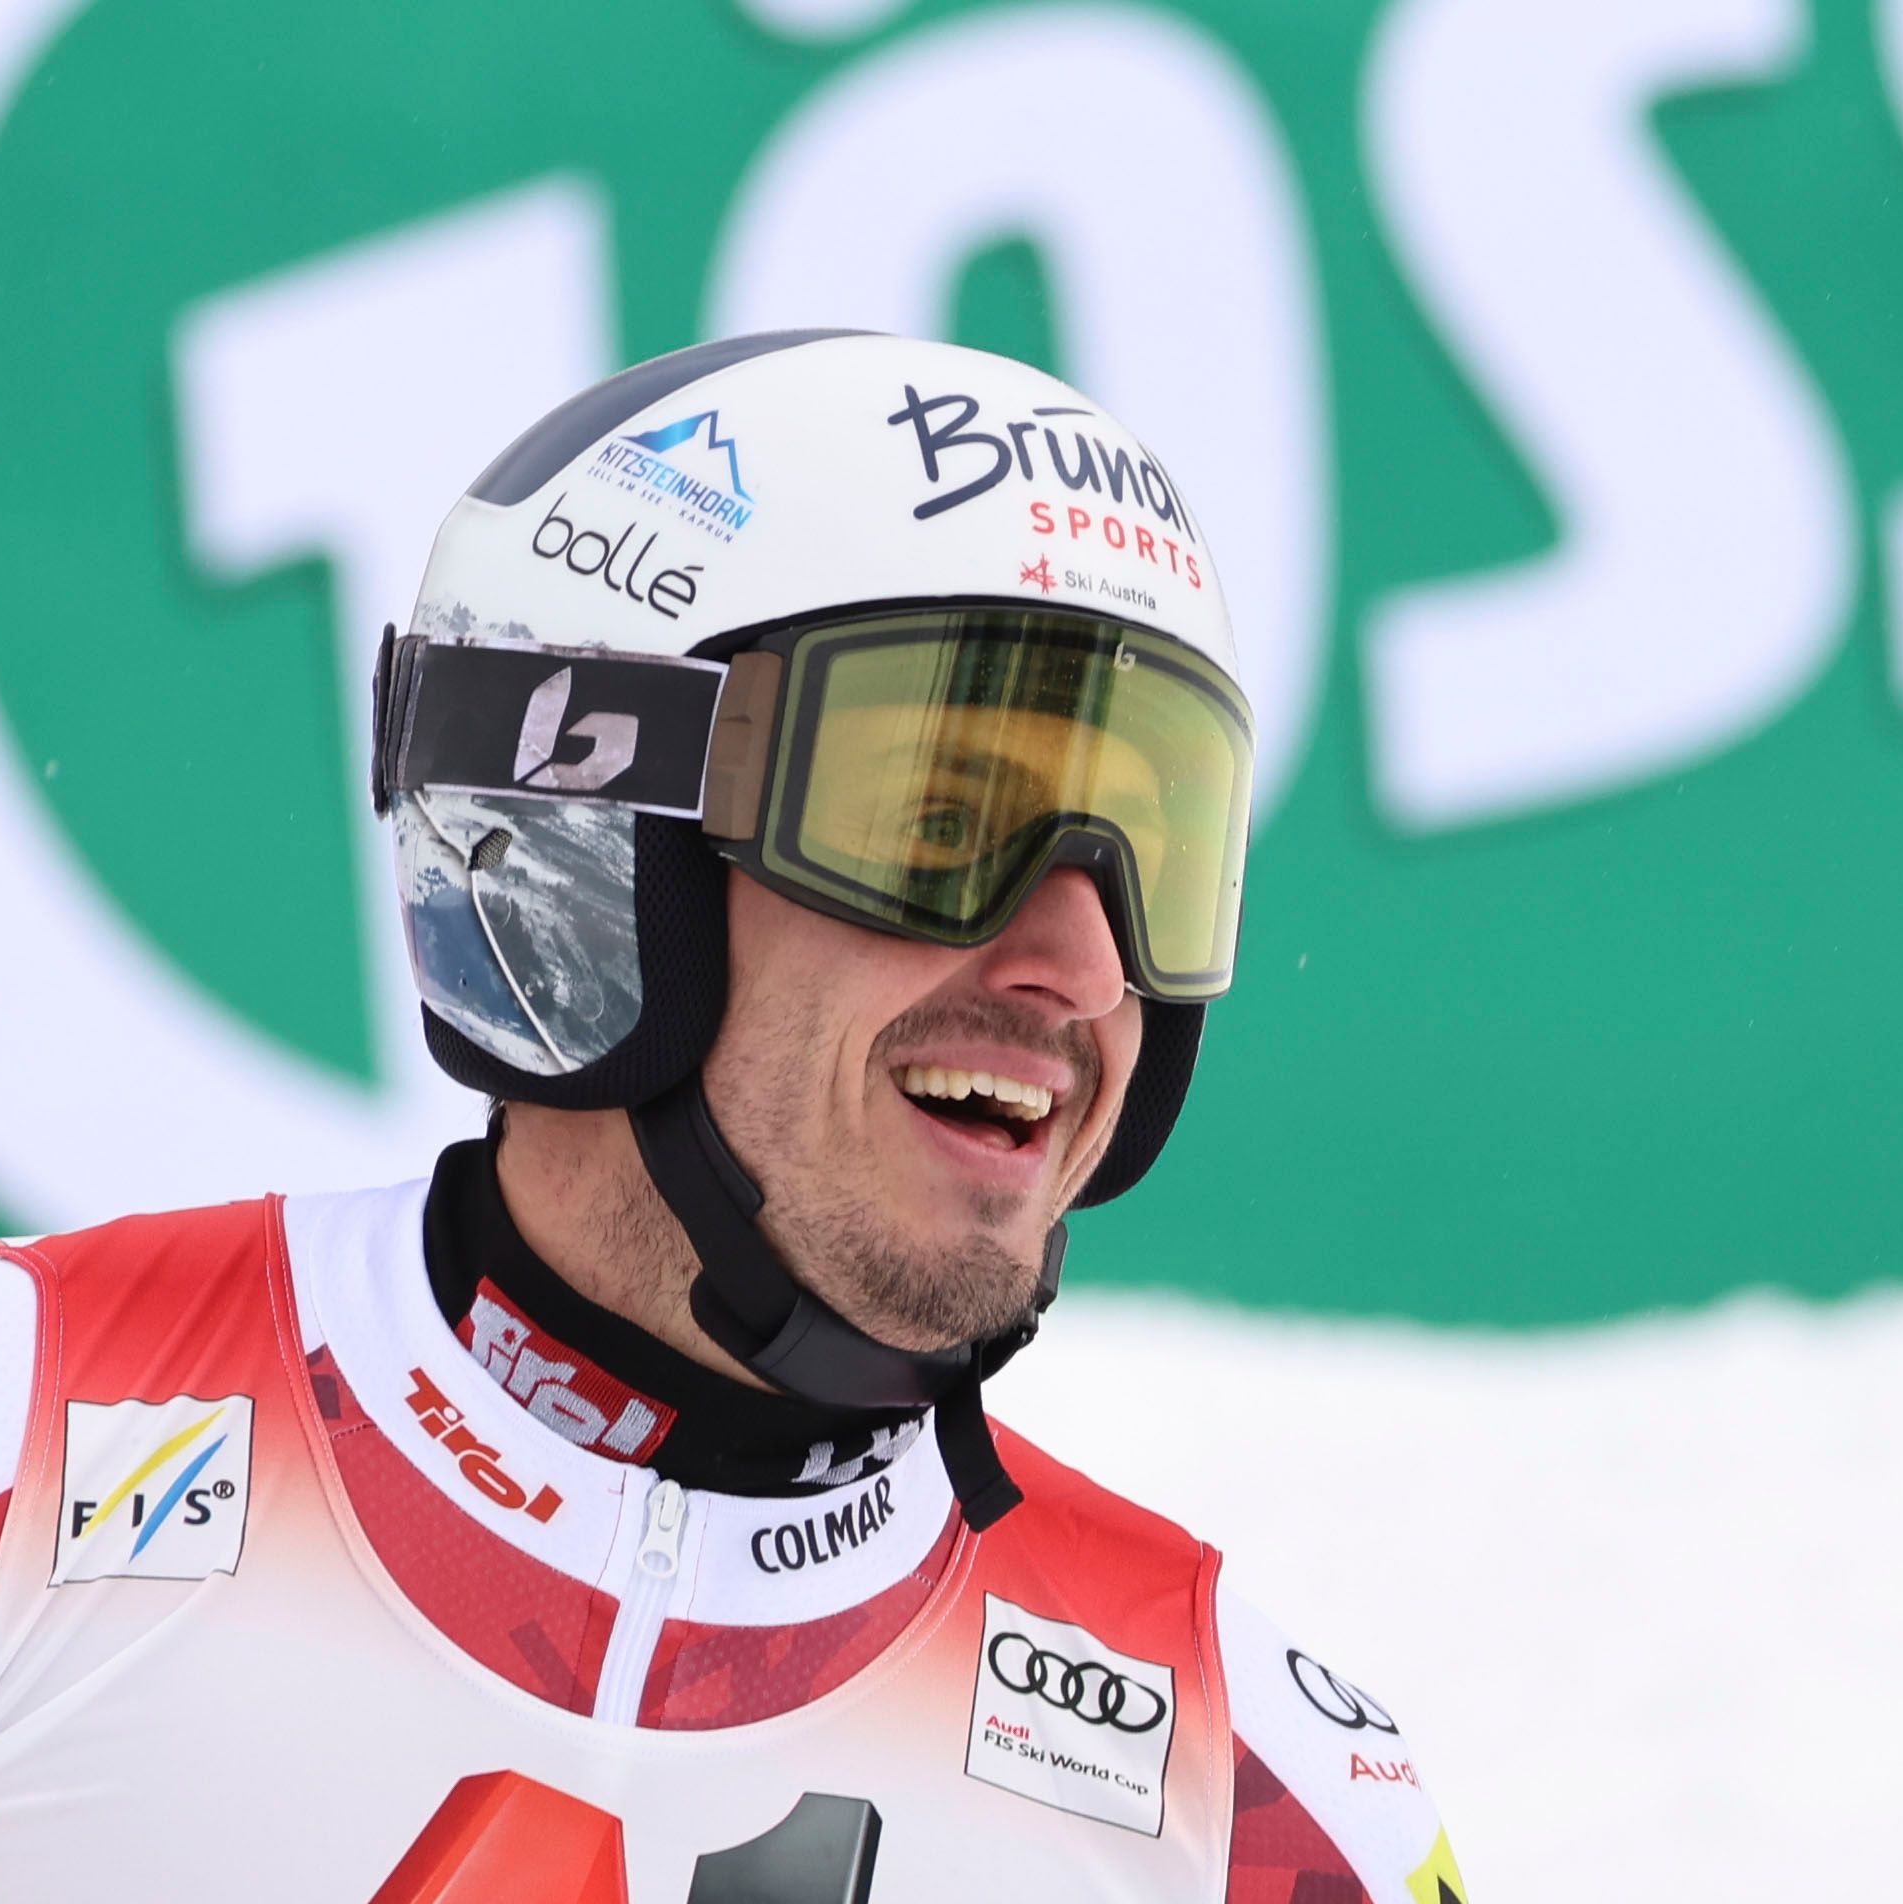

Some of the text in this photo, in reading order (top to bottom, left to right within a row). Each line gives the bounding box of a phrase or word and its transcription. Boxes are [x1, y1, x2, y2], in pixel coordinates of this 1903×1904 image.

[587, 465, 734, 545] ZELL AM SEE KAPRUN
[597, 442, 753, 530] KITZSTEINHORN
[532, 491, 704, 620] bollé
[1030, 502, 1201, 589] SPORTS
[1065, 570, 1156, 610] Ski Austria
[405, 1367, 564, 1524] Tirol
[751, 1474, 896, 1575] COLMAR
[984, 1730, 1148, 1795] FIS Ski World Cup
[986, 1714, 1030, 1740] Audi
